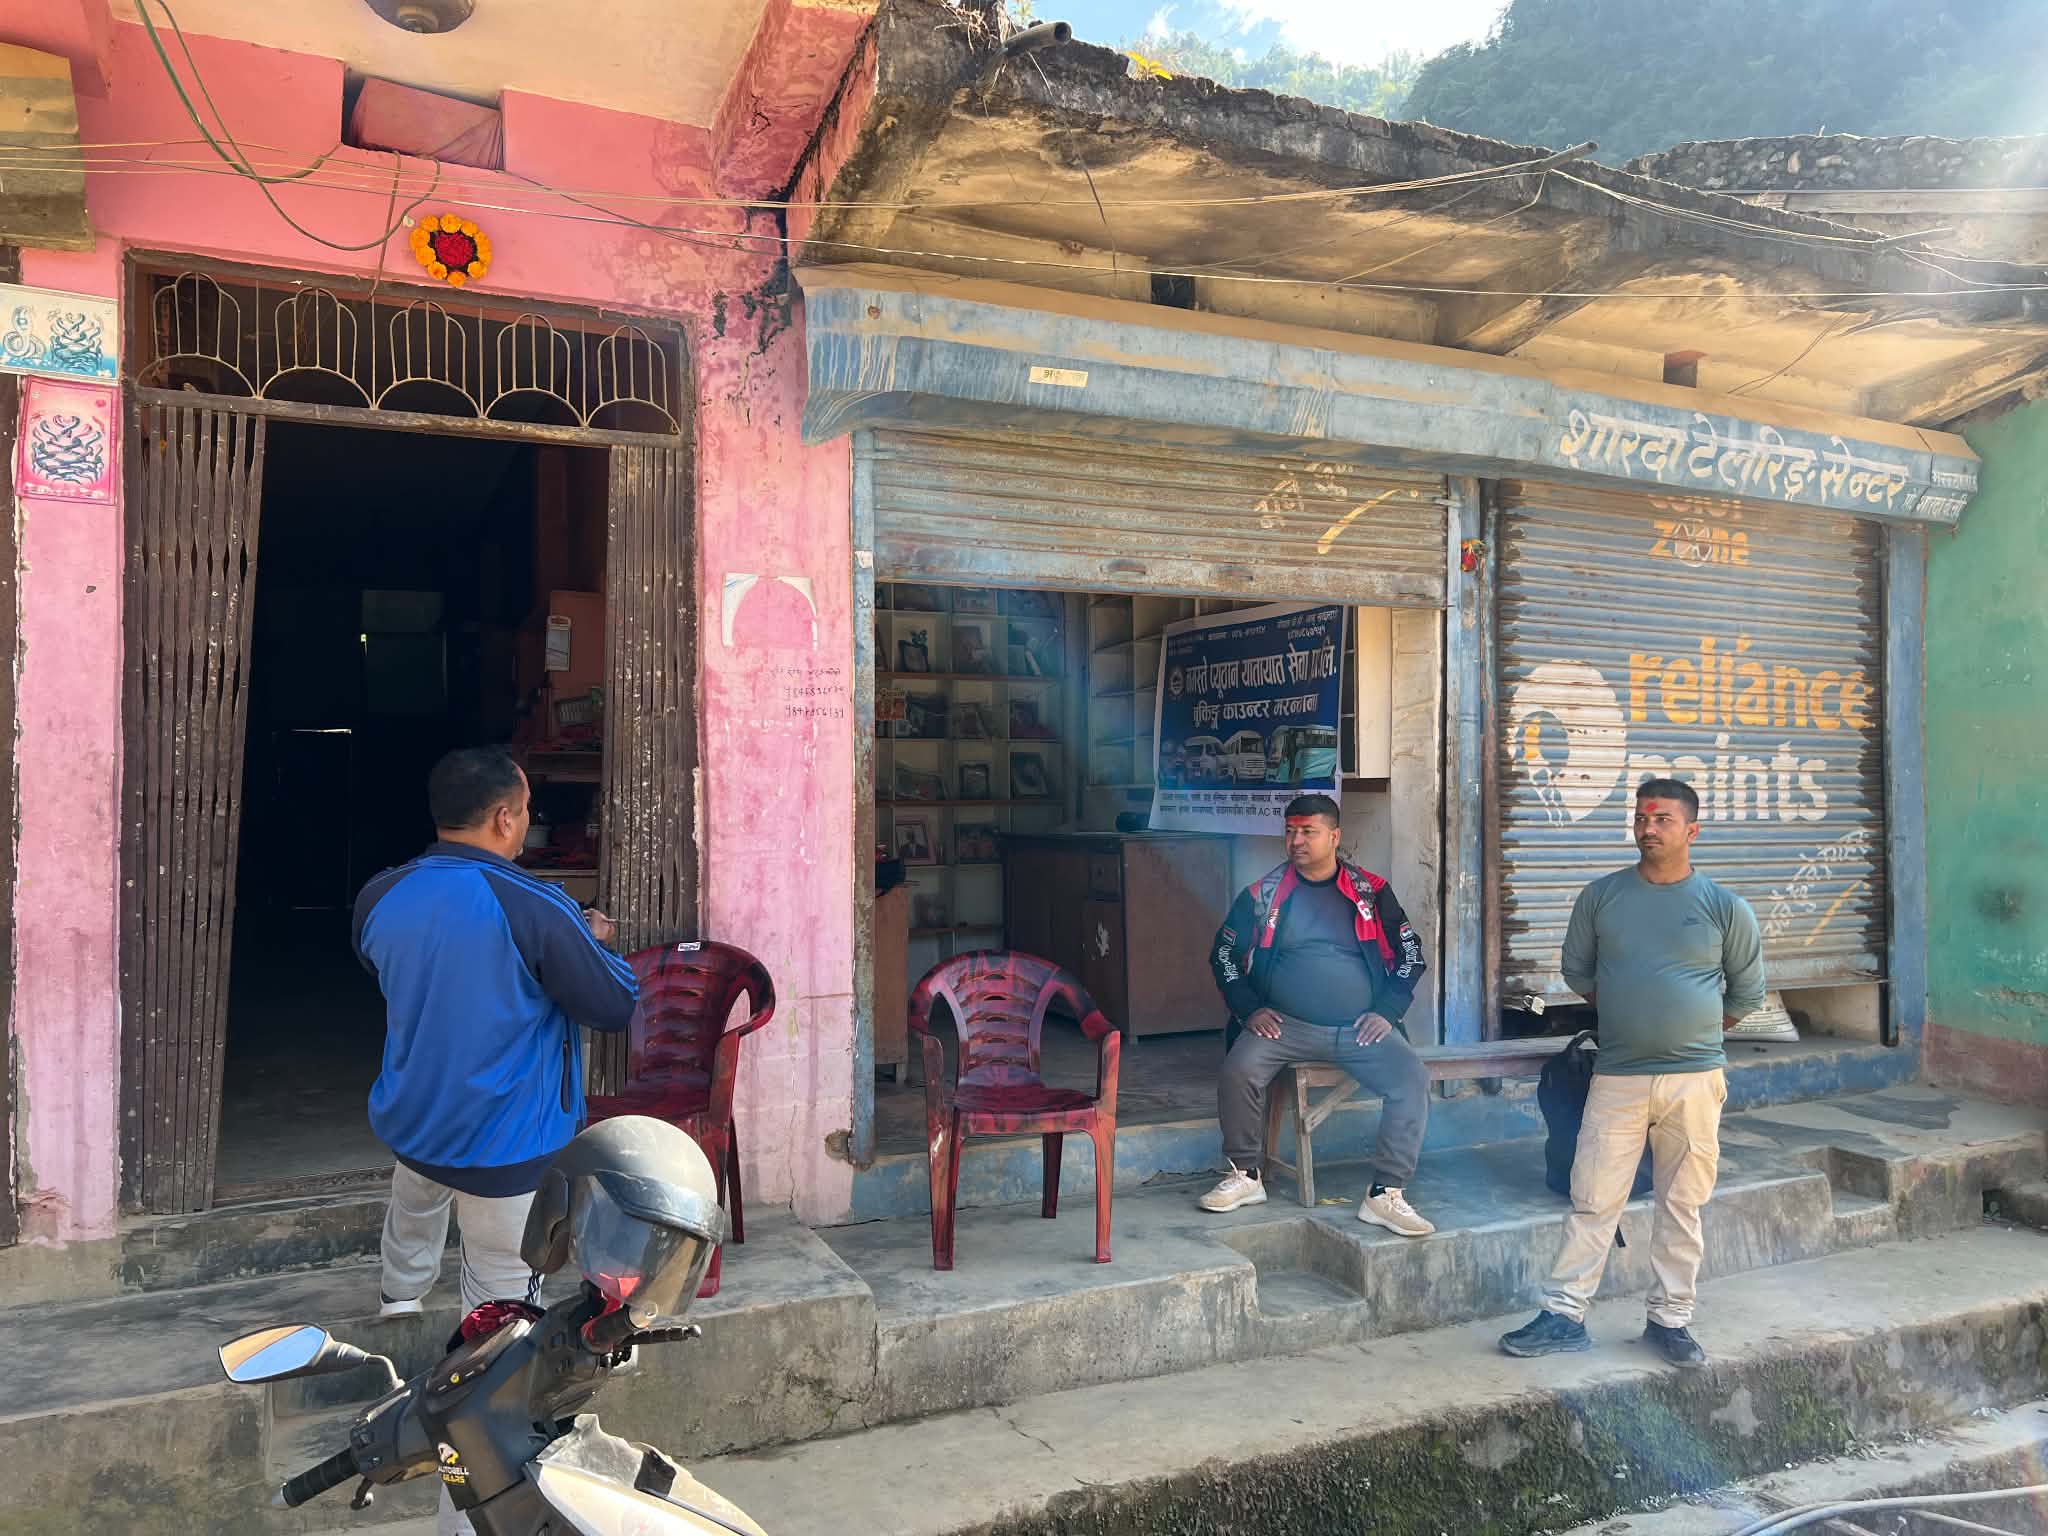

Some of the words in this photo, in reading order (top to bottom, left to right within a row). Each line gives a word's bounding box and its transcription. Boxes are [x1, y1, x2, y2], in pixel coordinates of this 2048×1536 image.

[1559, 409, 1689, 483] शारदा
[1819, 435, 1910, 511] सेन्टर
[1241, 653, 1286, 689] यातायात
[1286, 642, 1309, 688] सेवा
[1629, 634, 1875, 730] reliance
[1222, 699, 1271, 722] काउन्टर
